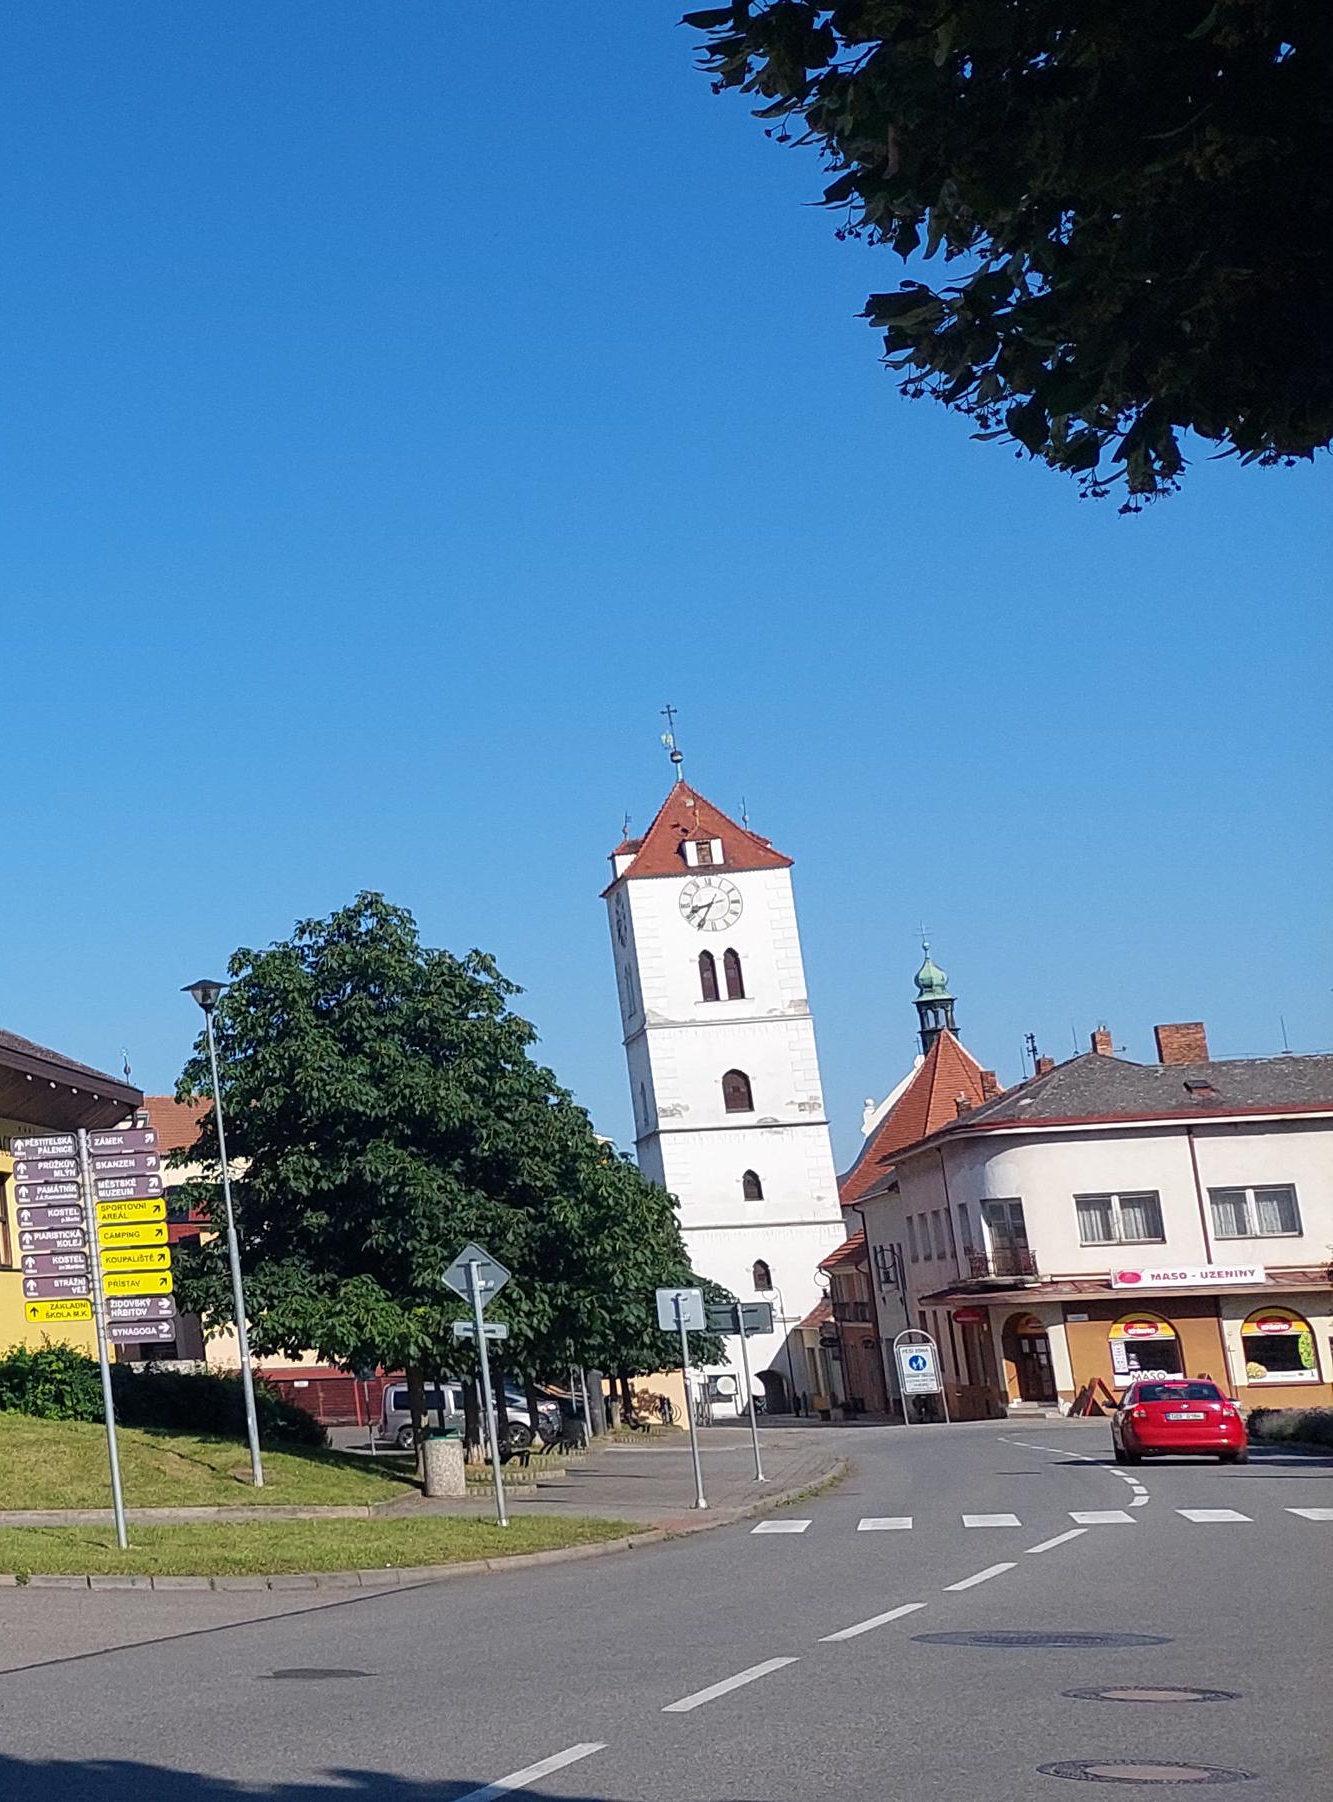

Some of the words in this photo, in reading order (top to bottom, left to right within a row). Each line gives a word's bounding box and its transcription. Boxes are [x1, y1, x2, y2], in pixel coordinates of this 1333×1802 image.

[94, 1136, 124, 1146] ZÁMEK
[95, 1159, 136, 1169] SKANZEN
[53, 1169, 76, 1177] MLÝN
[97, 1178, 137, 1189] MĚSTSKÉ
[37, 1184, 77, 1194] PAMÁTNÍK
[98, 1188, 134, 1197] MUZEUM
[100, 1202, 147, 1212] SPORTOVNÍ
[48, 1208, 80, 1217] KOSTEL
[101, 1211, 128, 1220] AREÁL
[34, 1229, 82, 1240] PIARISTICKÁ
[103, 1231, 141, 1240] CAMPING
[56, 1239, 82, 1248] KOLEJ
[52, 1255, 85, 1265] KOSTEL
[105, 1253, 155, 1264] KOUPALIŠTĚ
[1150, 1272, 1188, 1281] MASO
[1200, 1269, 1256, 1279] UZENINY
[107, 1279, 141, 1288] PŘÍSTAV
[50, 1302, 89, 1310] ZÁKLADNÍ
[45, 1309, 72, 1319] ŠKOLA
[110, 1308, 148, 1317] HŘBITOV
[112, 1327, 158, 1337] SYNAGOGA
[1131, 1371, 1167, 1381] MASO
